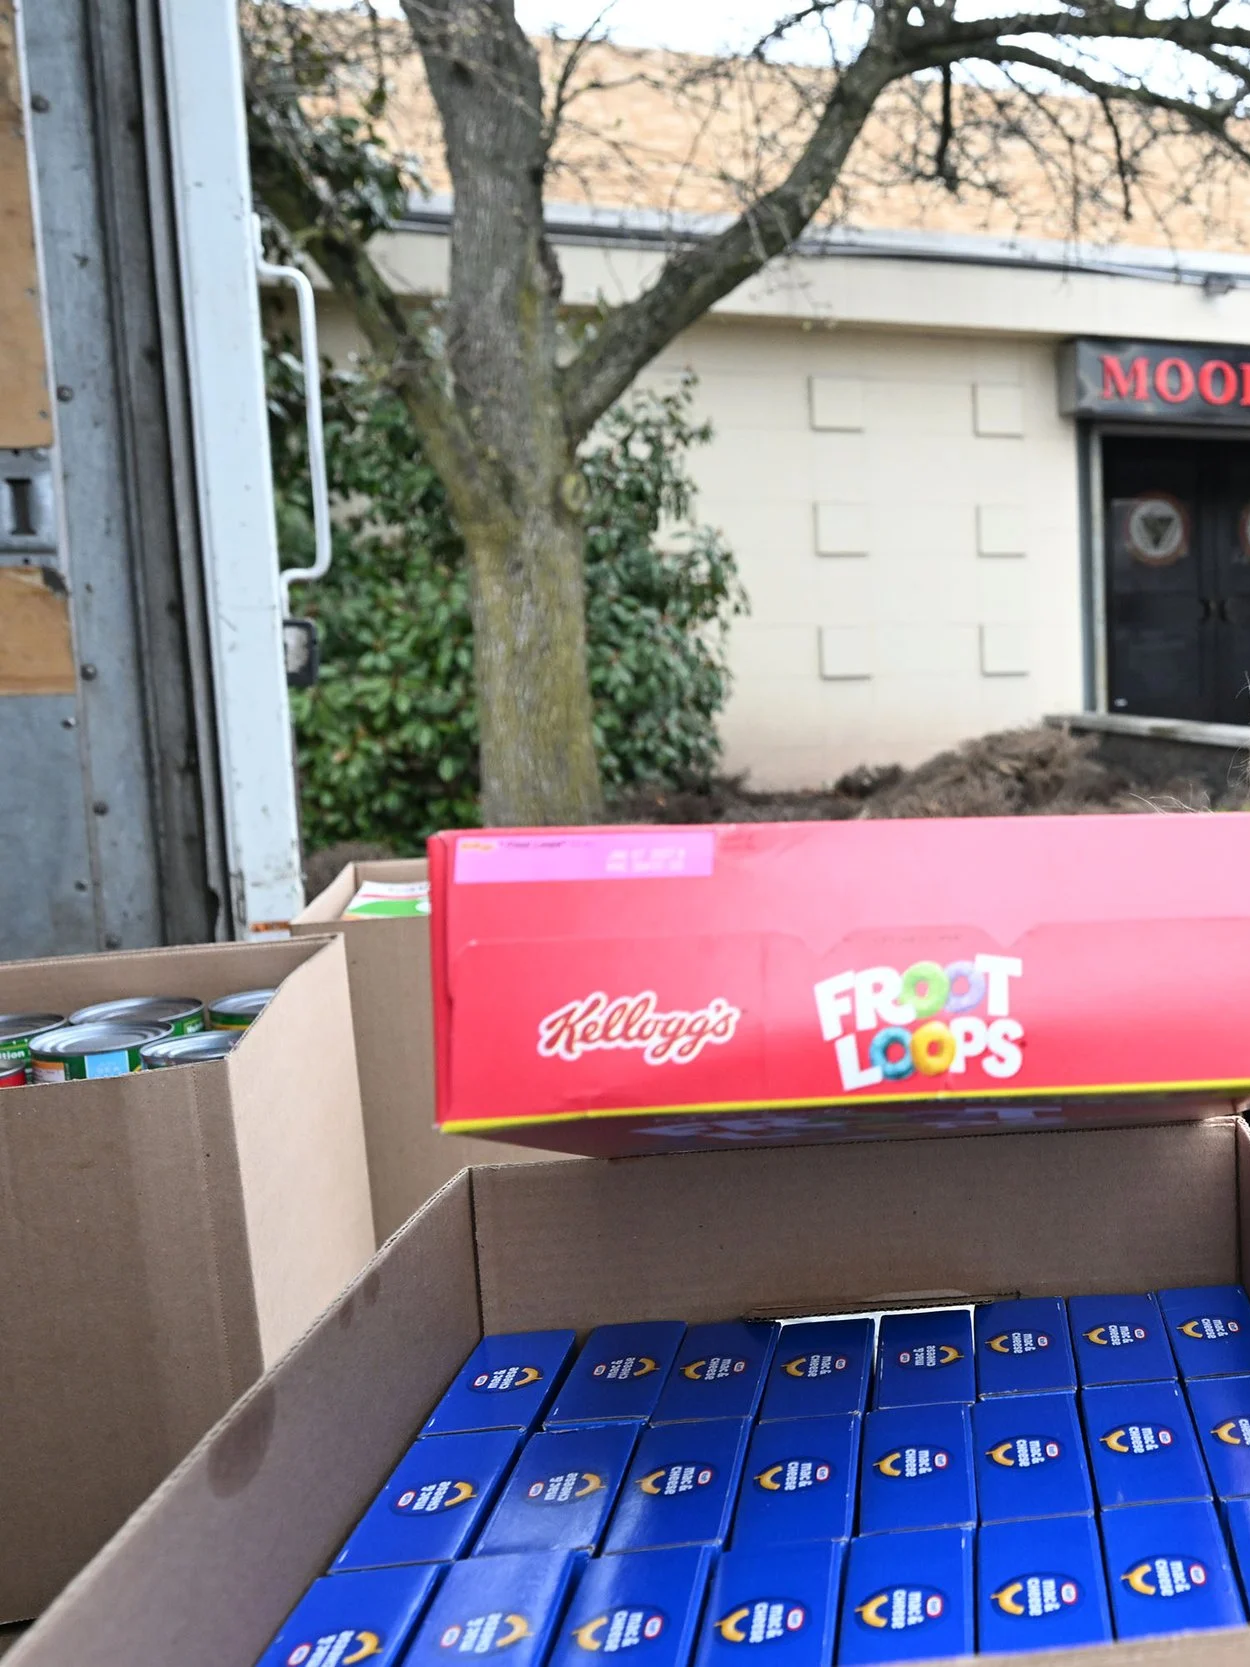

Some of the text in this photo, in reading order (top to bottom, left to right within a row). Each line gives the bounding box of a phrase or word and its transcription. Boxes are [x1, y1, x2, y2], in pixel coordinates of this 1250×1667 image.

[537, 990, 741, 1065] Kellogg's
[814, 953, 1023, 1042] FROOT
[835, 1016, 1025, 1092] LOOPS
